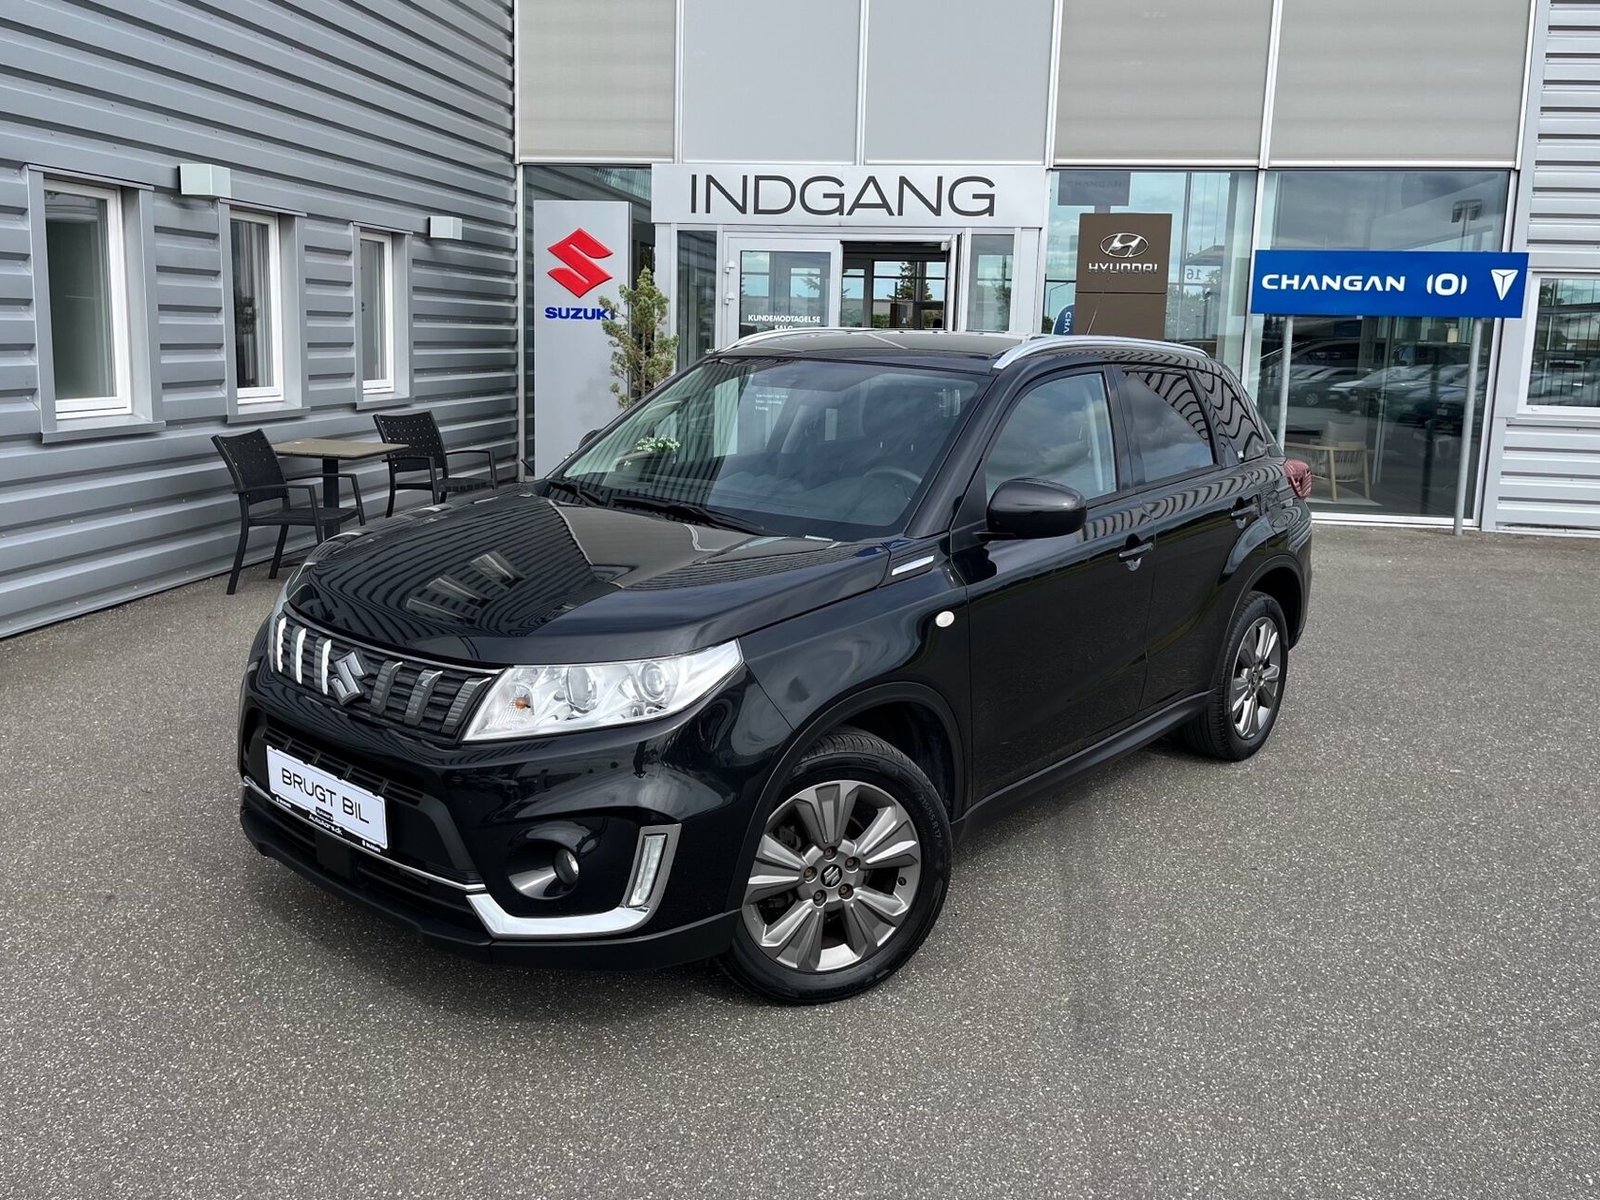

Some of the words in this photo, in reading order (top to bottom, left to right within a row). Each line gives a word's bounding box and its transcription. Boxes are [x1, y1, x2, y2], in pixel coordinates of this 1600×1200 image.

[690, 174, 996, 216] INDGANG
[1088, 262, 1158, 274] HYUNDAI
[1261, 274, 1406, 292] CHANGAN
[544, 306, 616, 320] SUZUKI
[747, 314, 821, 323] KUNDEMODTAGELSE
[281, 767, 337, 807] BRUGT
[342, 796, 370, 825] BIL
